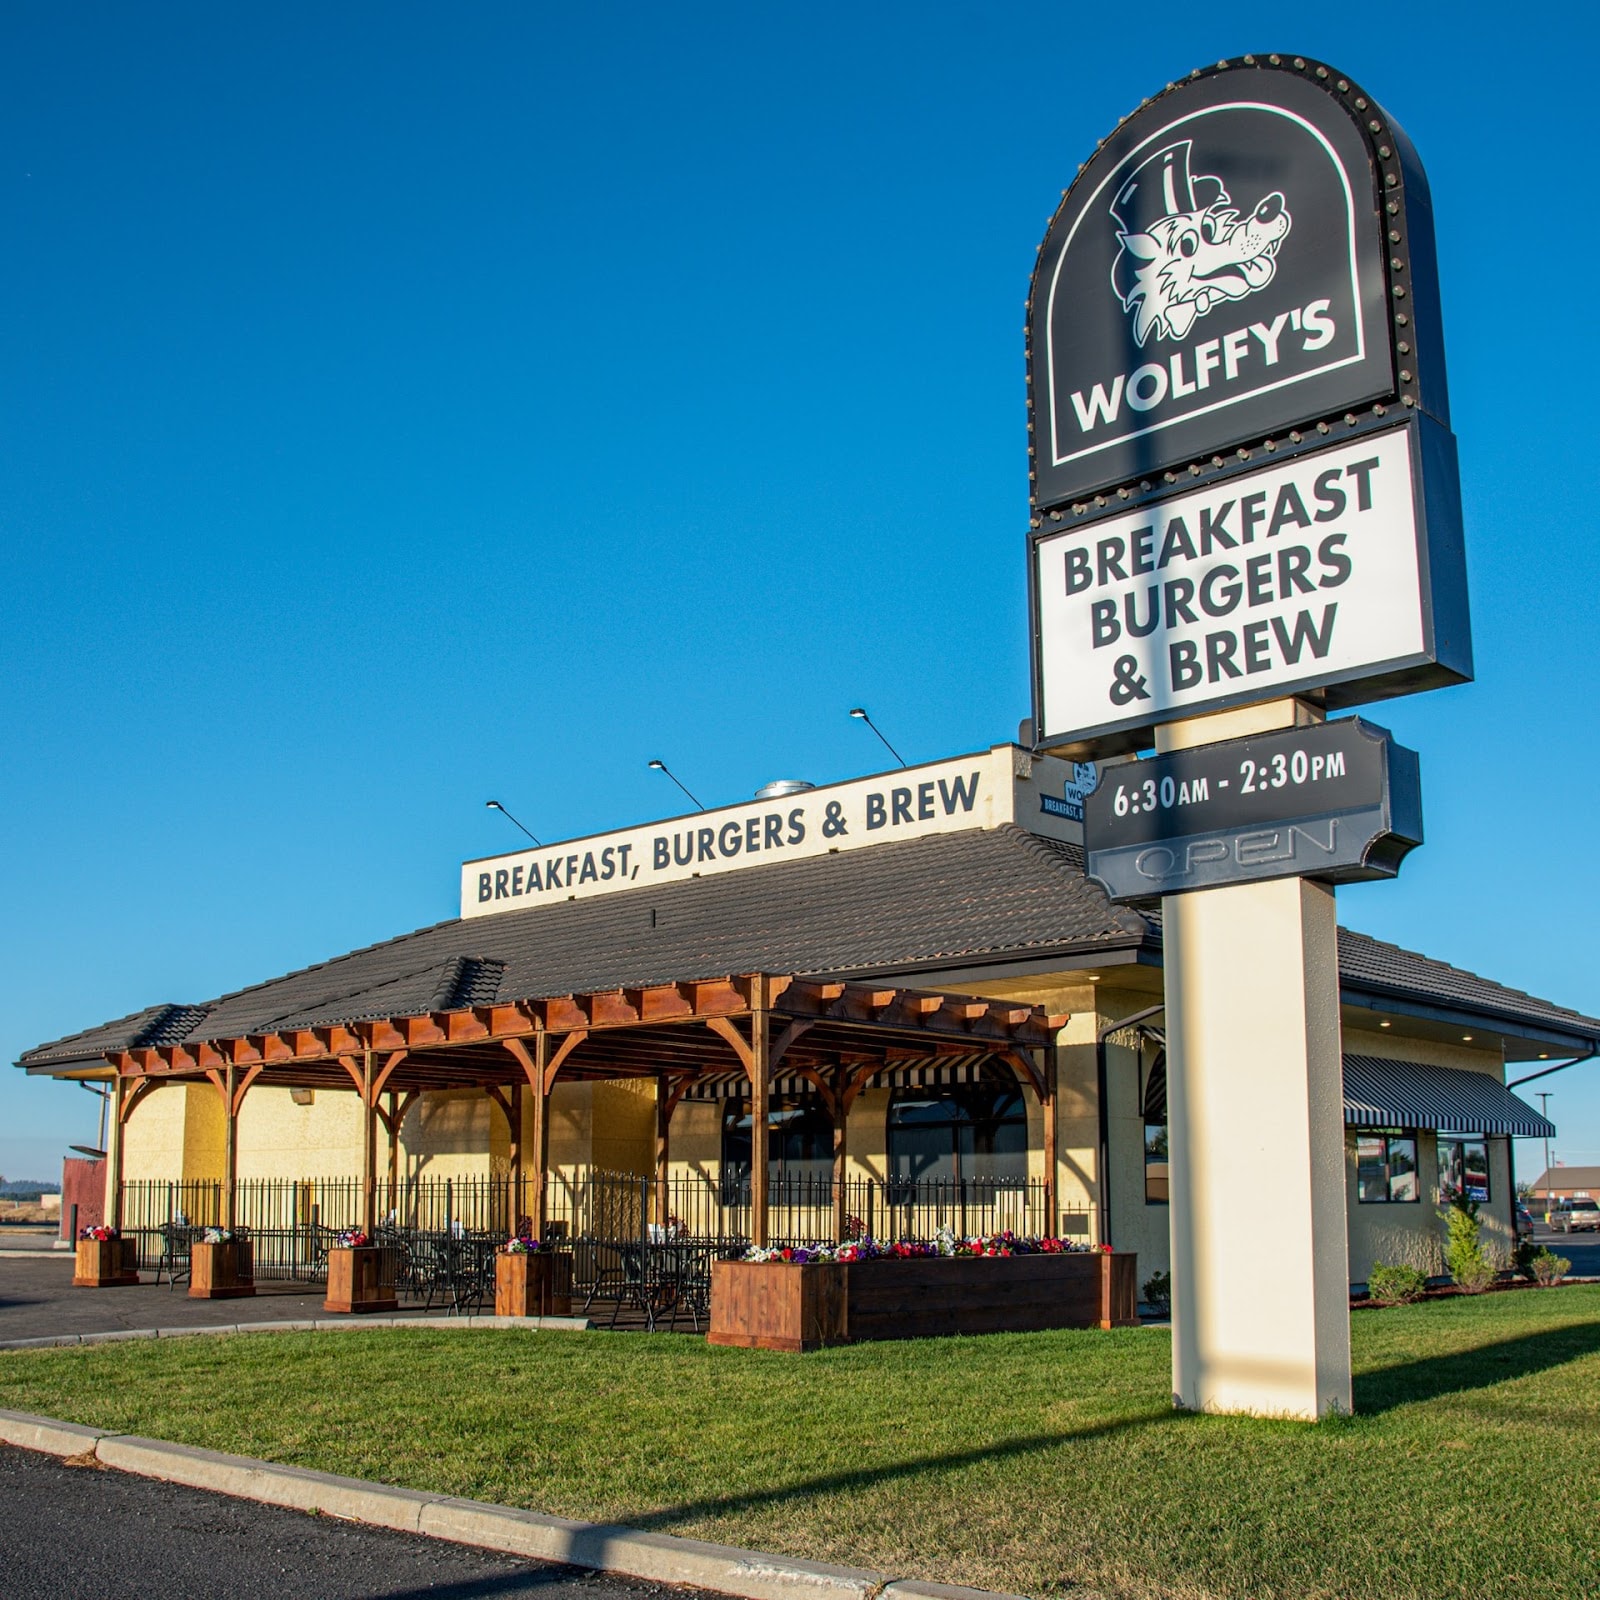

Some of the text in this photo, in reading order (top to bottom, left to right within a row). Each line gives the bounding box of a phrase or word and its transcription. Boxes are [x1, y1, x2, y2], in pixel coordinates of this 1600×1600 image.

[1070, 299, 1336, 433] WOLFFY'S
[1064, 456, 1380, 597] BREAKFAST
[1091, 533, 1352, 649] BURGERS
[1108, 602, 1338, 706] & BREW
[478, 771, 981, 902] BREAKFAST, BURGERS & BREW
[1113, 776, 1209, 817] 6:30AM
[1240, 750, 1346, 795] 2:30PM
[1135, 818, 1340, 881] OPEN
